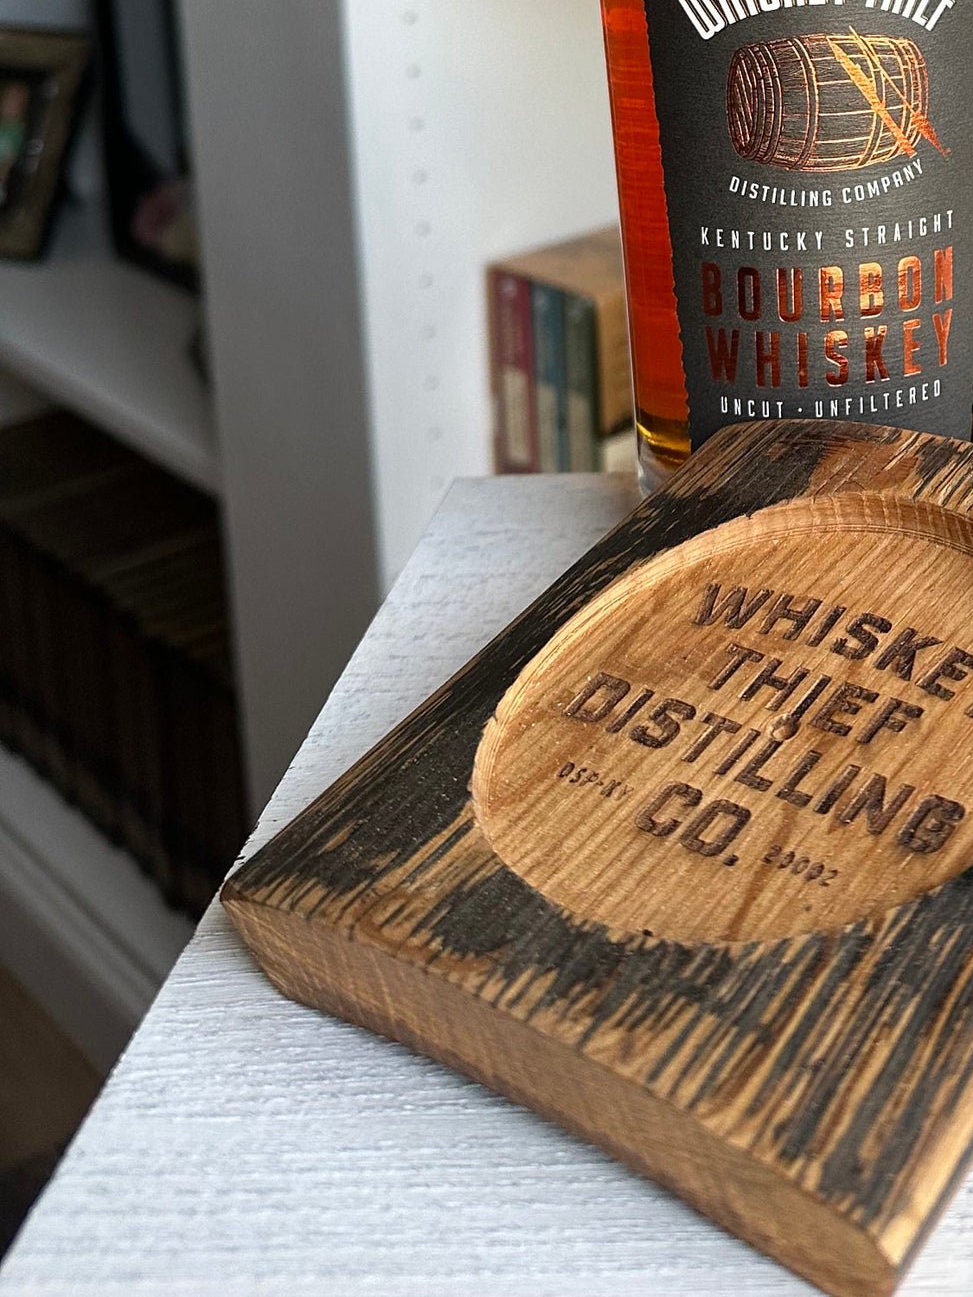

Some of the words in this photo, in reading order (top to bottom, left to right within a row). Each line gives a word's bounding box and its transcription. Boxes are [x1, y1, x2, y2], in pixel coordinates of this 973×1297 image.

[729, 175, 832, 207] DISTILLING
[842, 158, 924, 204] COMPANY
[701, 226, 824, 251] KENTUCKY
[845, 210, 954, 248] STRAIGHT
[701, 246, 953, 323] BOURBON
[705, 308, 953, 388] WHISKEY
[720, 395, 783, 419] UNCUT
[815, 378, 941, 418] UNFILTERED
[707, 642, 924, 745] THIEF
[565, 671, 967, 855] DISTILLING
[635, 779, 752, 867] CO.
